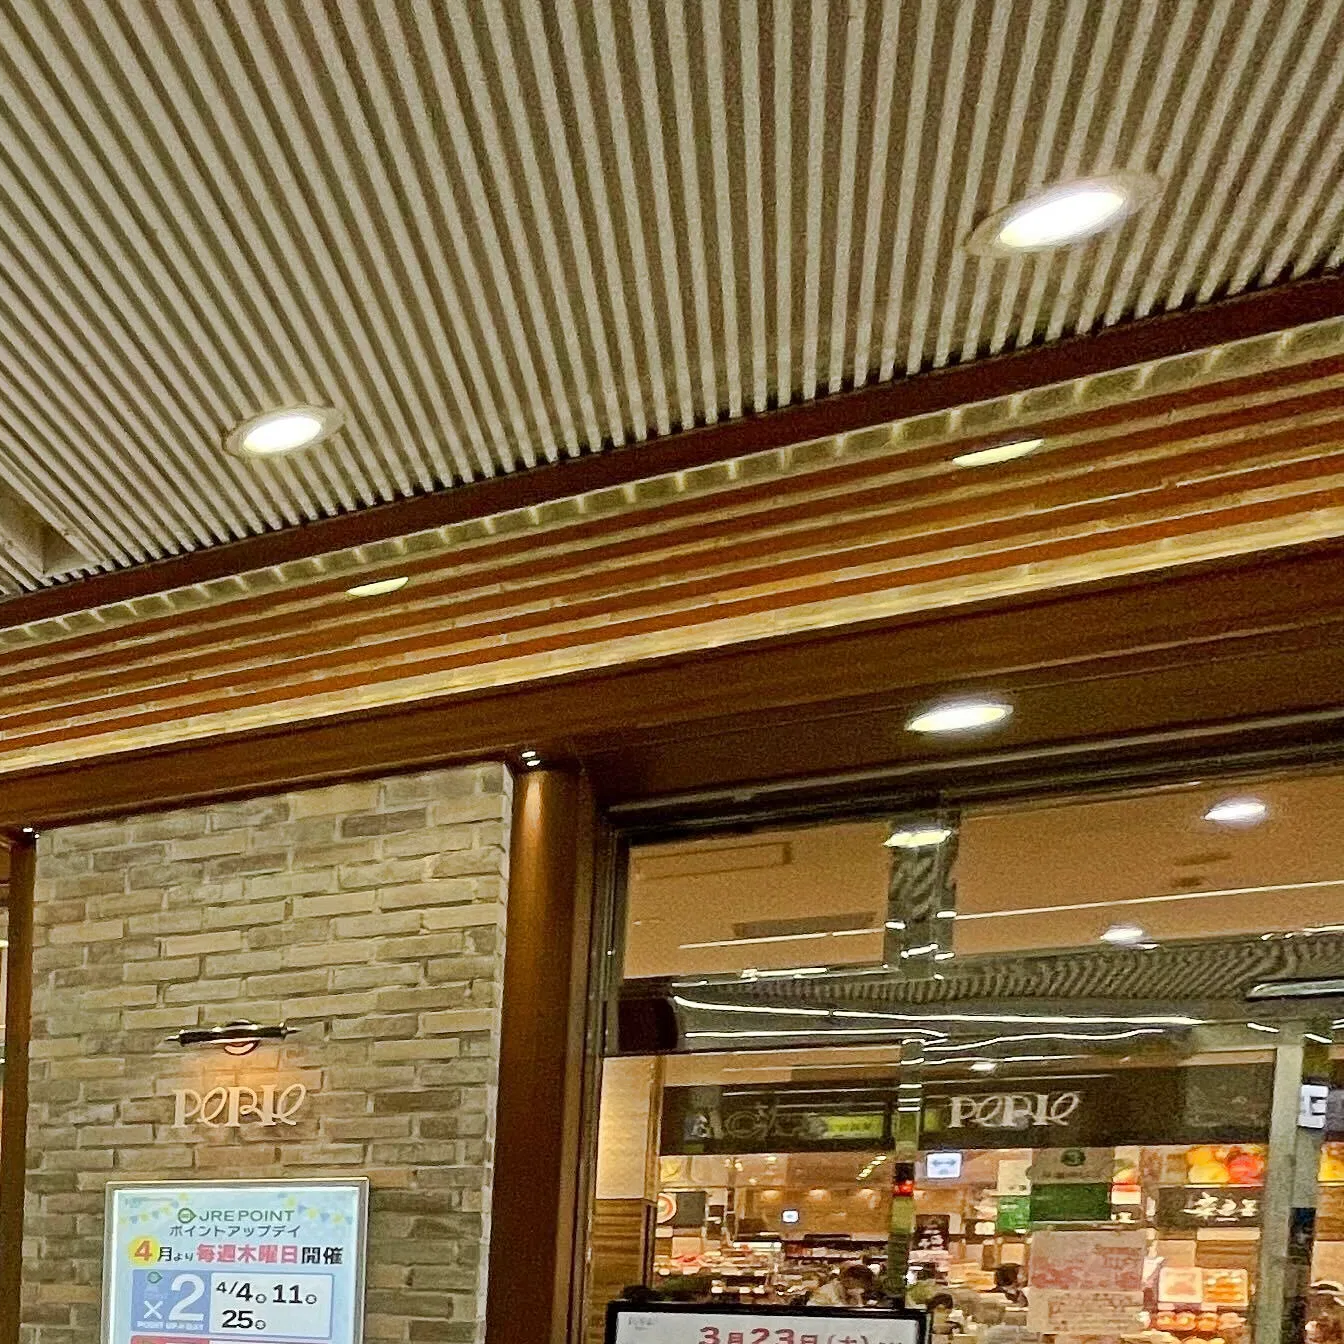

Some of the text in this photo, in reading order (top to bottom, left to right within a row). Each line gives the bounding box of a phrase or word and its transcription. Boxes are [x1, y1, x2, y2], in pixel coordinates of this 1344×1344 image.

[199, 1209, 295, 1222] JRE POINT
[169, 1225, 301, 1238] ポイントアップデイ
